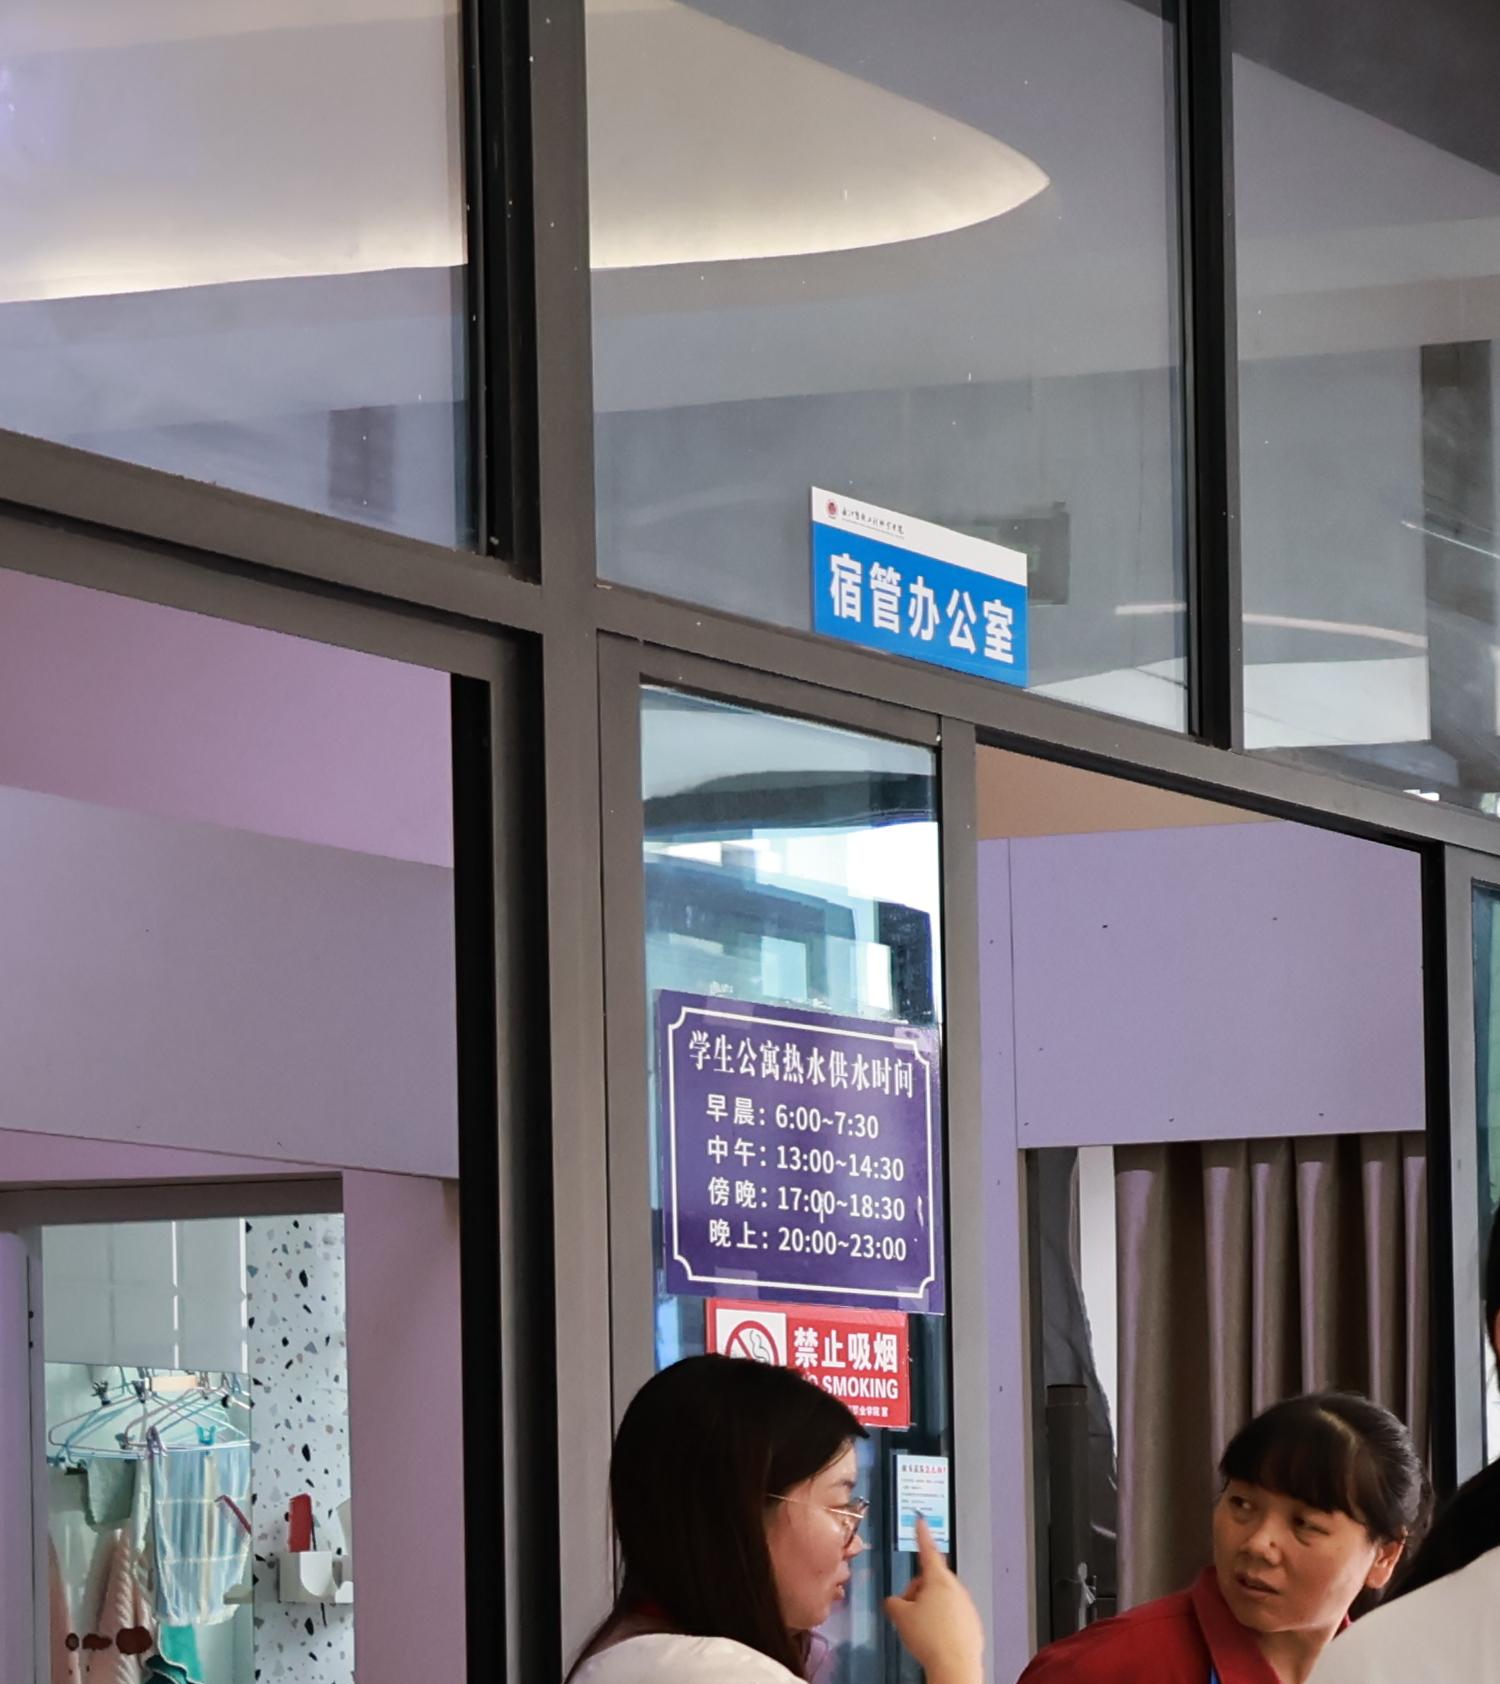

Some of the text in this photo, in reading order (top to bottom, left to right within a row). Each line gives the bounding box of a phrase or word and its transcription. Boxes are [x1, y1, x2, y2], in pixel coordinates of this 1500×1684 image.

[830, 553, 1014, 663] 宿管办公室
[689, 1030, 914, 1098] 学生公寓热水供水时间
[794, 1326, 898, 1373] 禁止吸烟
[822, 1375, 898, 1400] SMOKING
